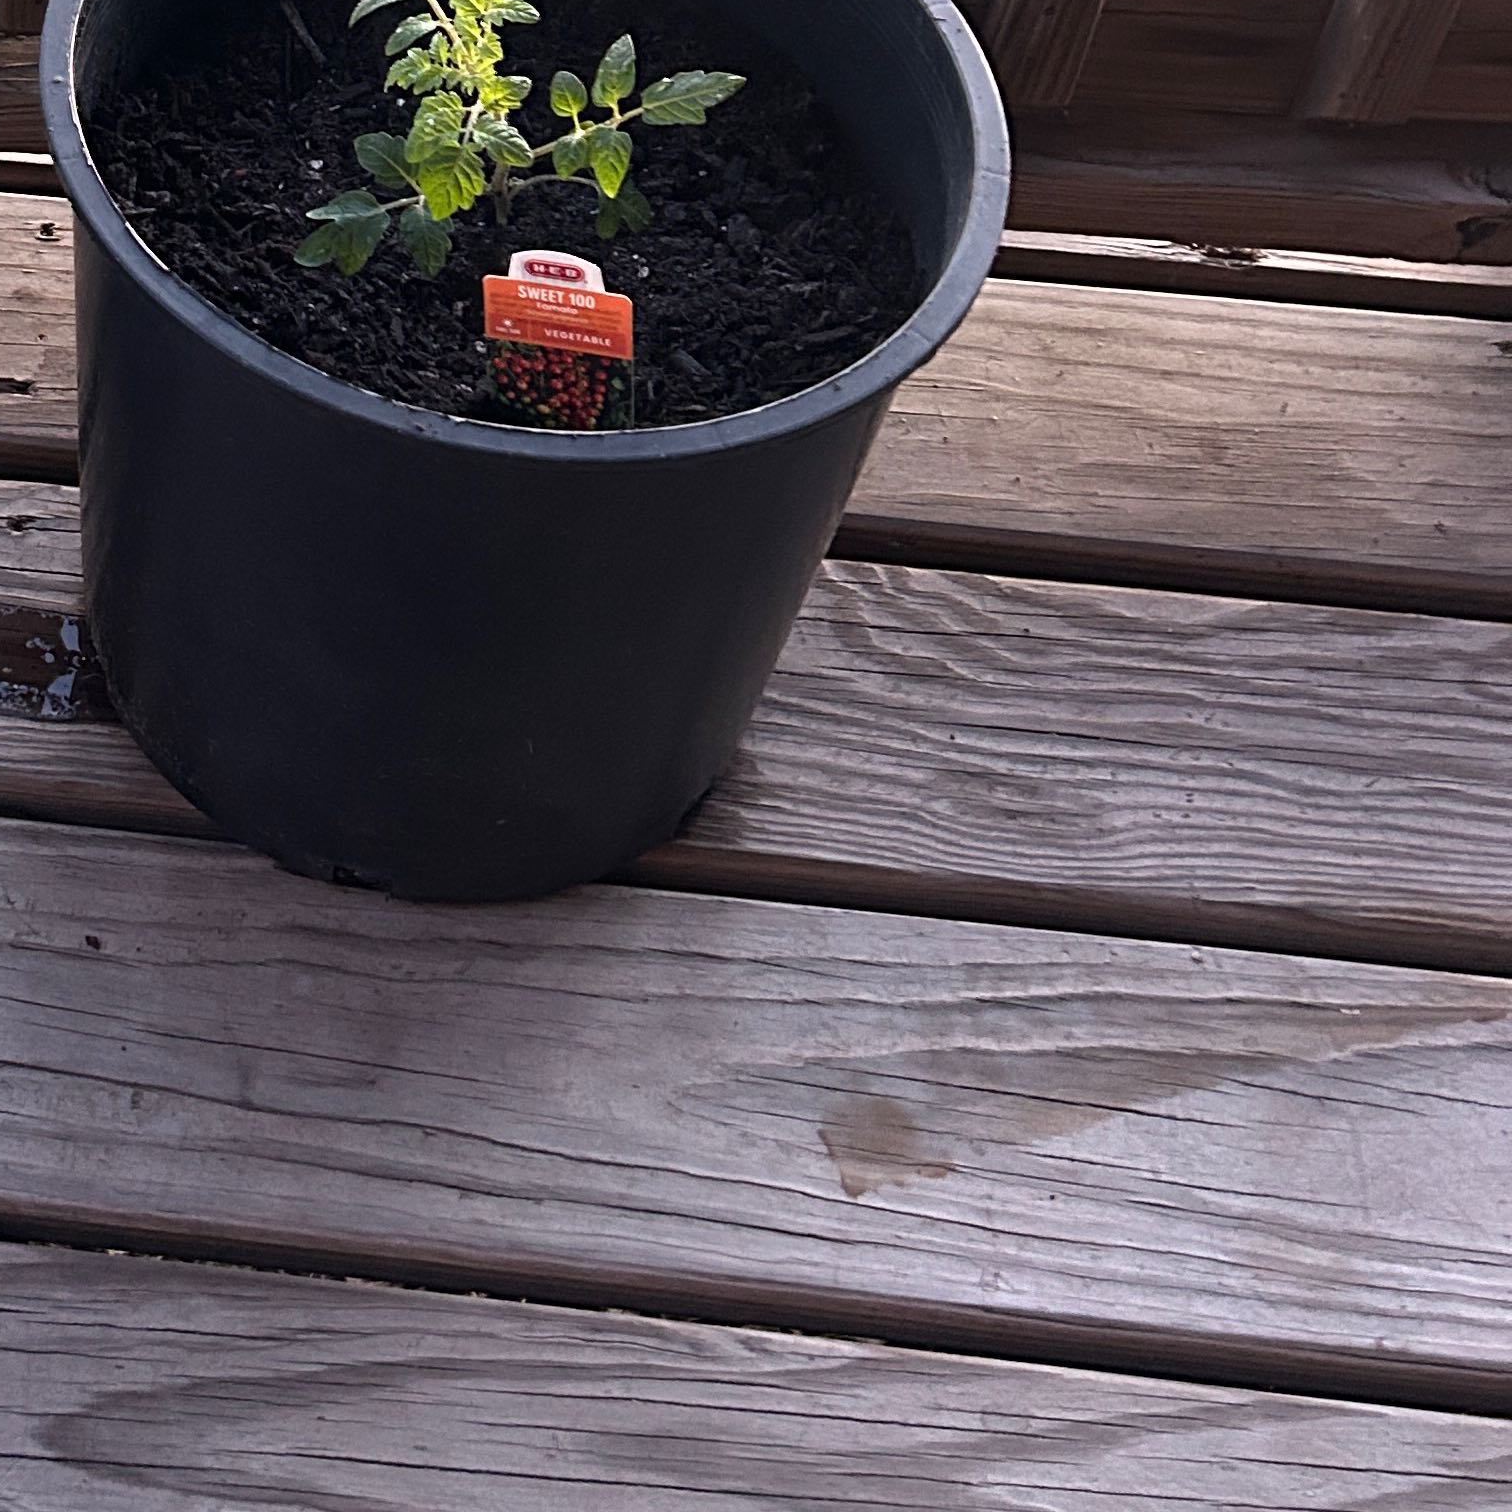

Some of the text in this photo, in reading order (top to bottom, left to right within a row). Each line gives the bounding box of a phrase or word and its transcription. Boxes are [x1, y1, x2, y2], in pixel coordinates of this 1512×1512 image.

[517, 285, 596, 309] SWEET 100
[536, 302, 579, 315] Tomato
[543, 328, 611, 347] VEGETABLE
